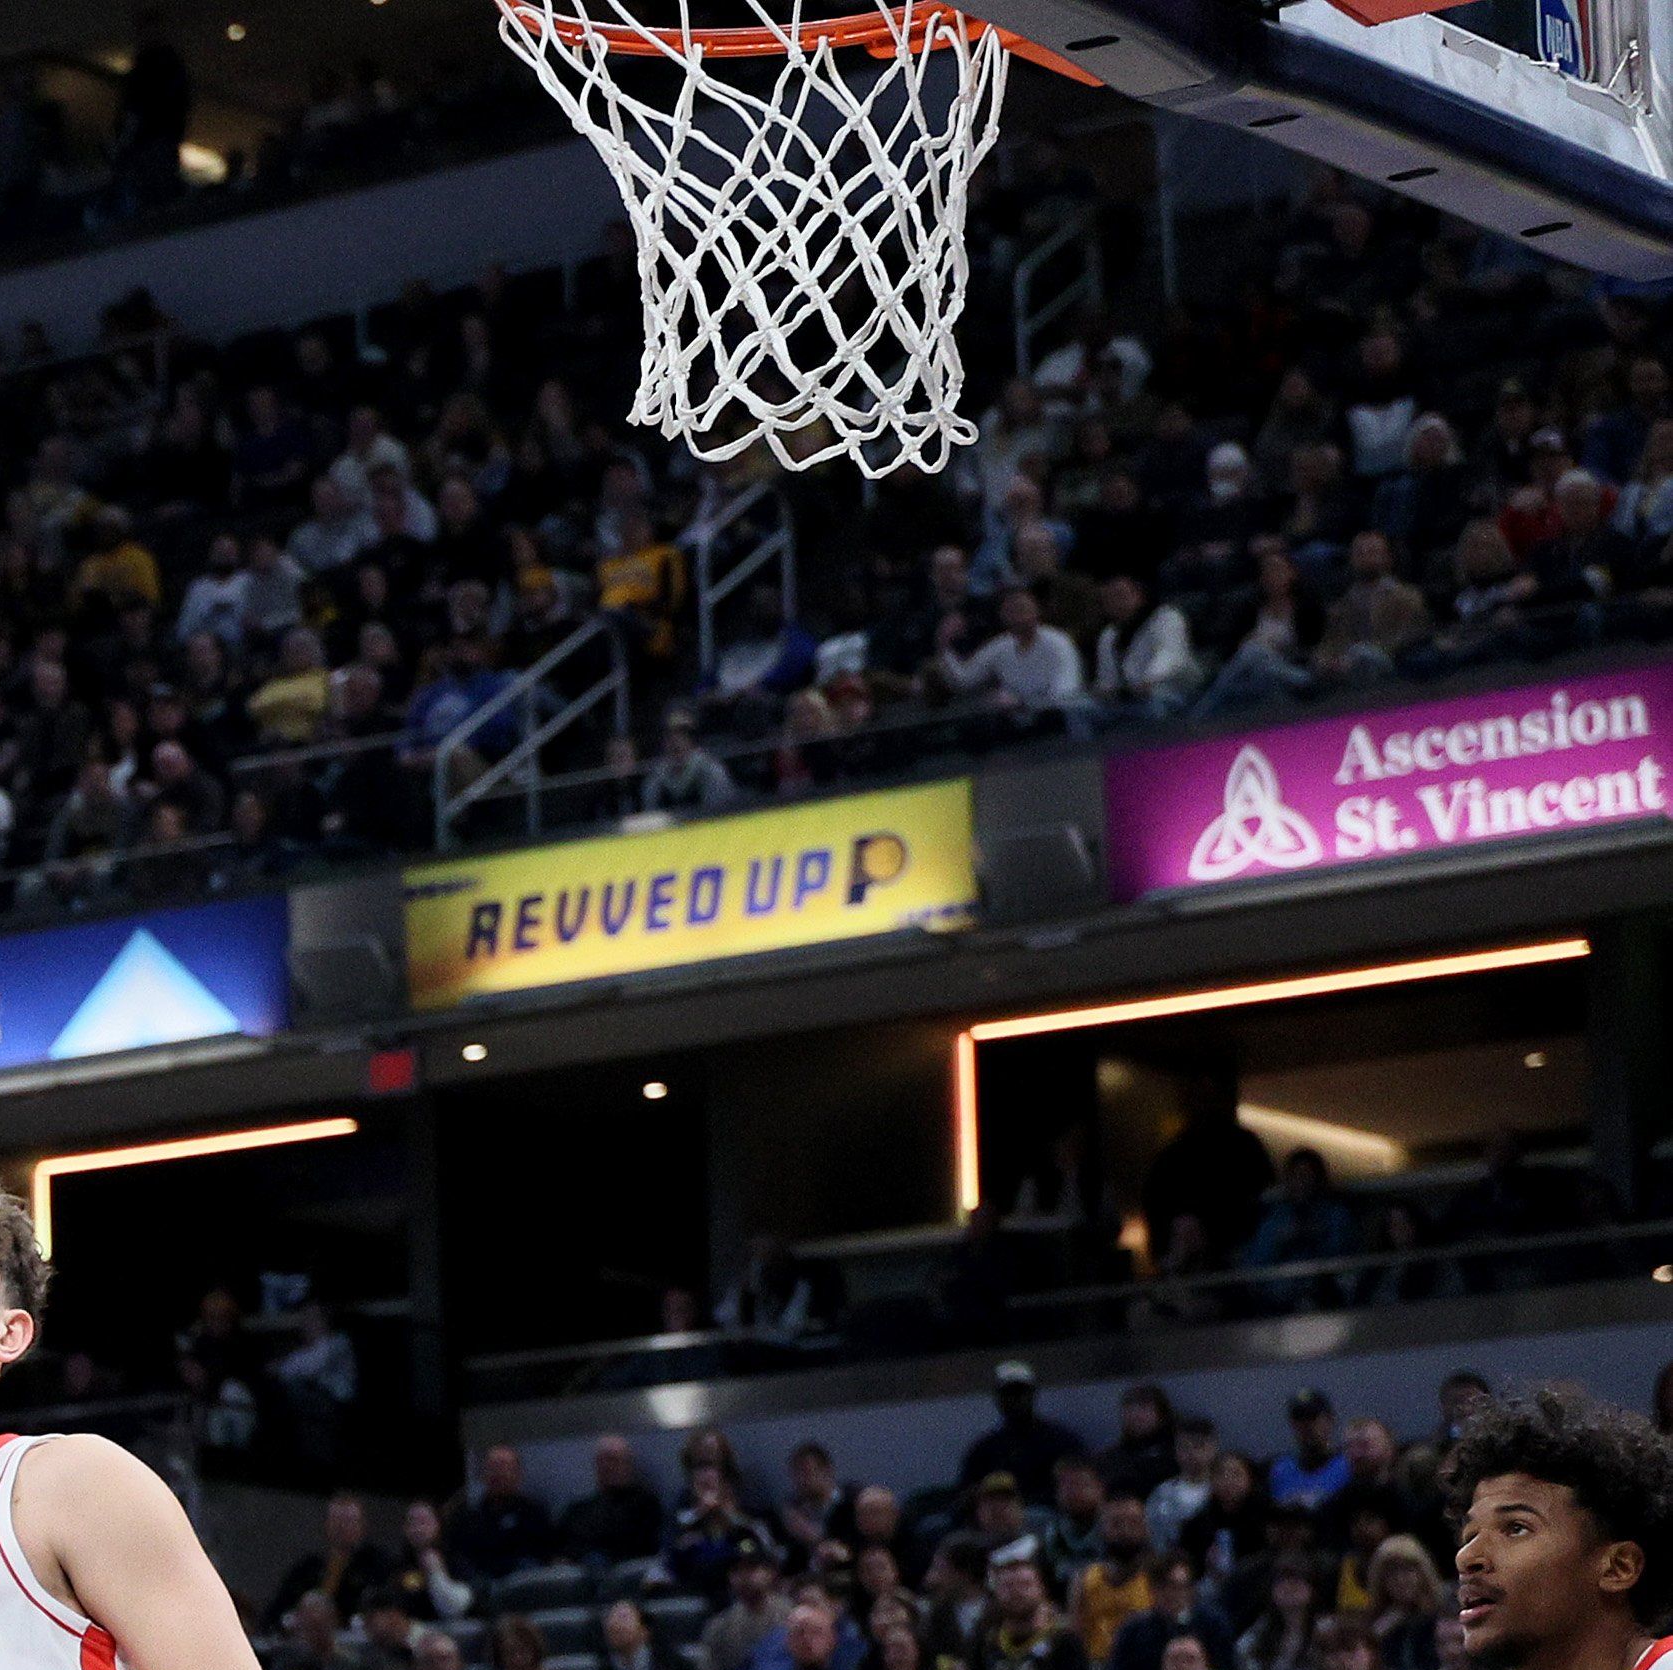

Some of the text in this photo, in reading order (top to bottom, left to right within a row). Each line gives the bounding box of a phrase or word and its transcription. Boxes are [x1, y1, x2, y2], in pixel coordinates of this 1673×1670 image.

[1332, 689, 1648, 785] Ascension
[1332, 752, 1666, 859] St. Vincent
[465, 864, 725, 959] REVVED
[744, 847, 834, 917] UP
